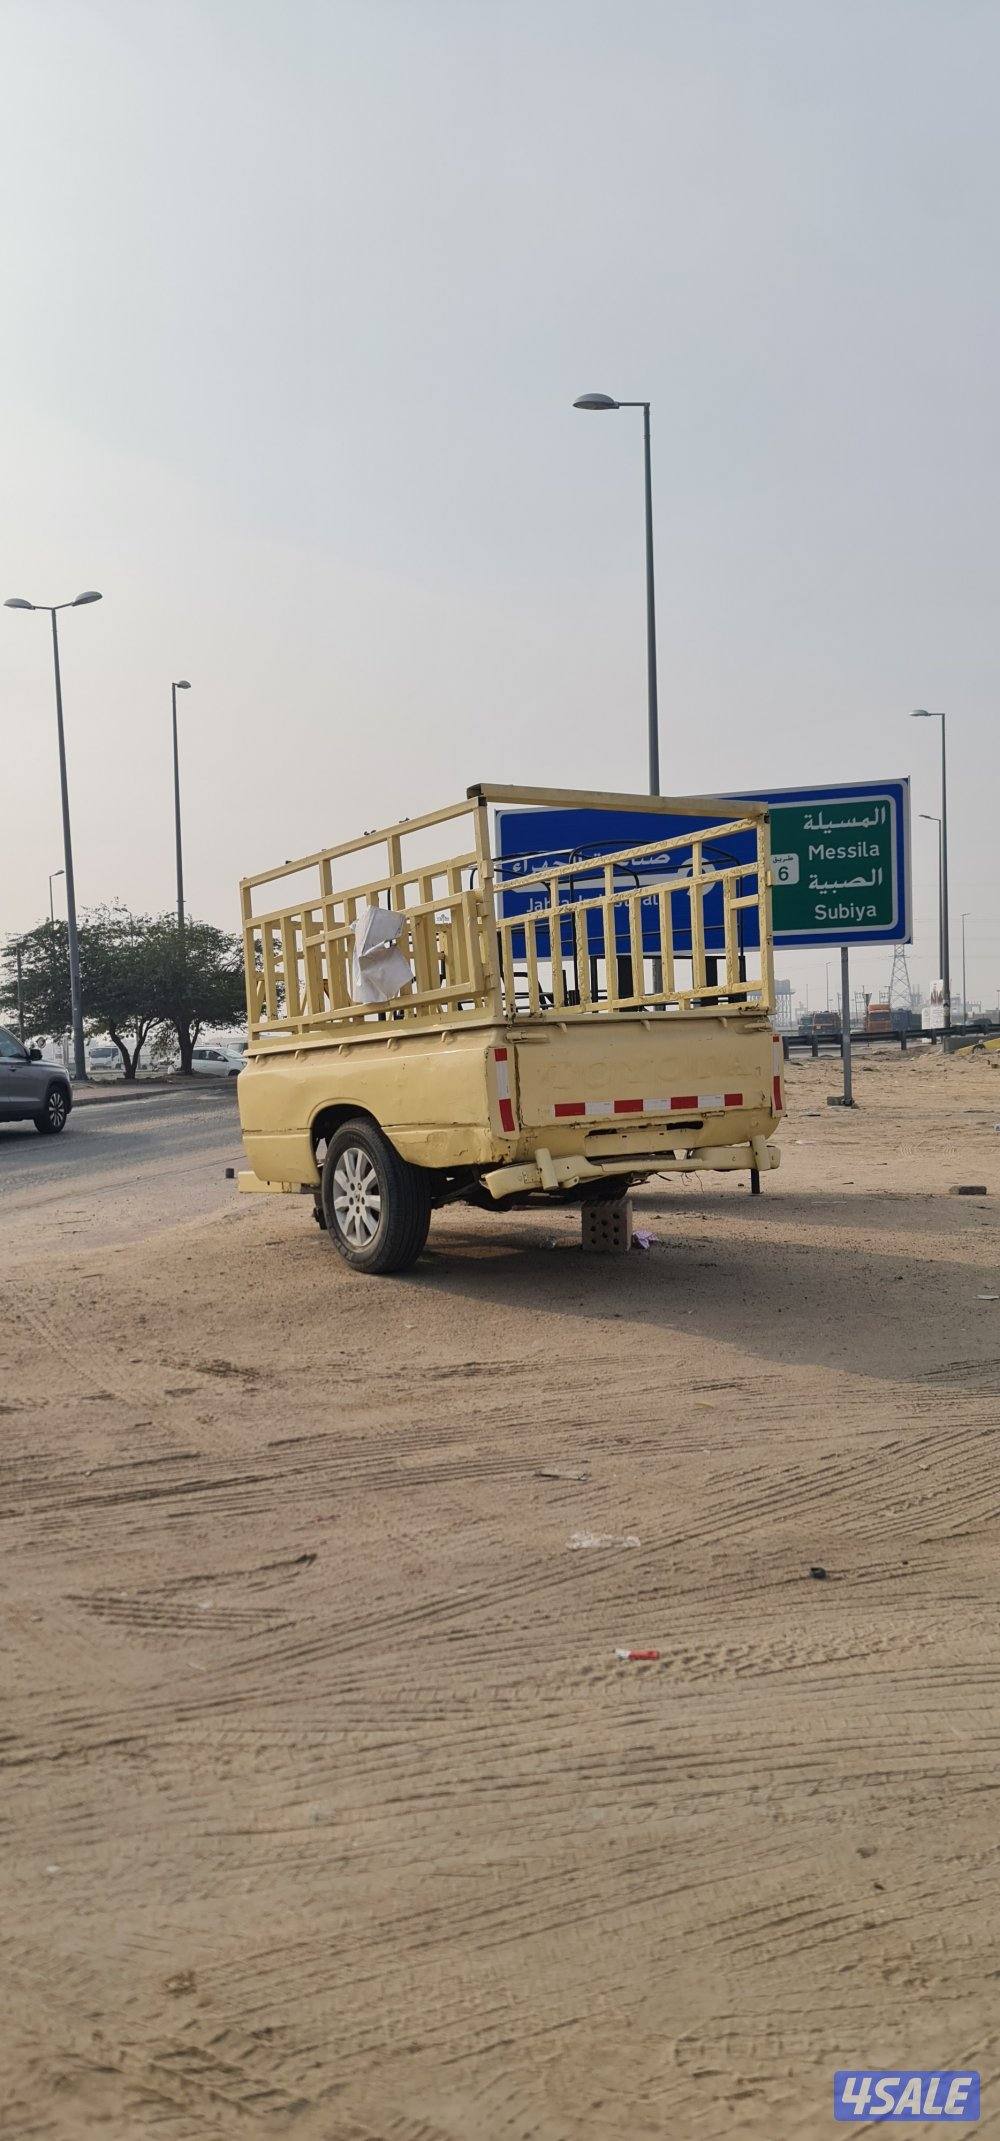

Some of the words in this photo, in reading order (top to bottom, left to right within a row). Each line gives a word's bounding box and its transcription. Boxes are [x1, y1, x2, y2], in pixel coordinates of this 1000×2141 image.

[803, 806, 886, 834] المسيلة
[772, 855, 794, 864] طريق
[808, 841, 880, 861] Messila
[778, 866, 789, 881] 6
[808, 867, 883, 894] الصبية
[814, 902, 877, 922] Subiya
